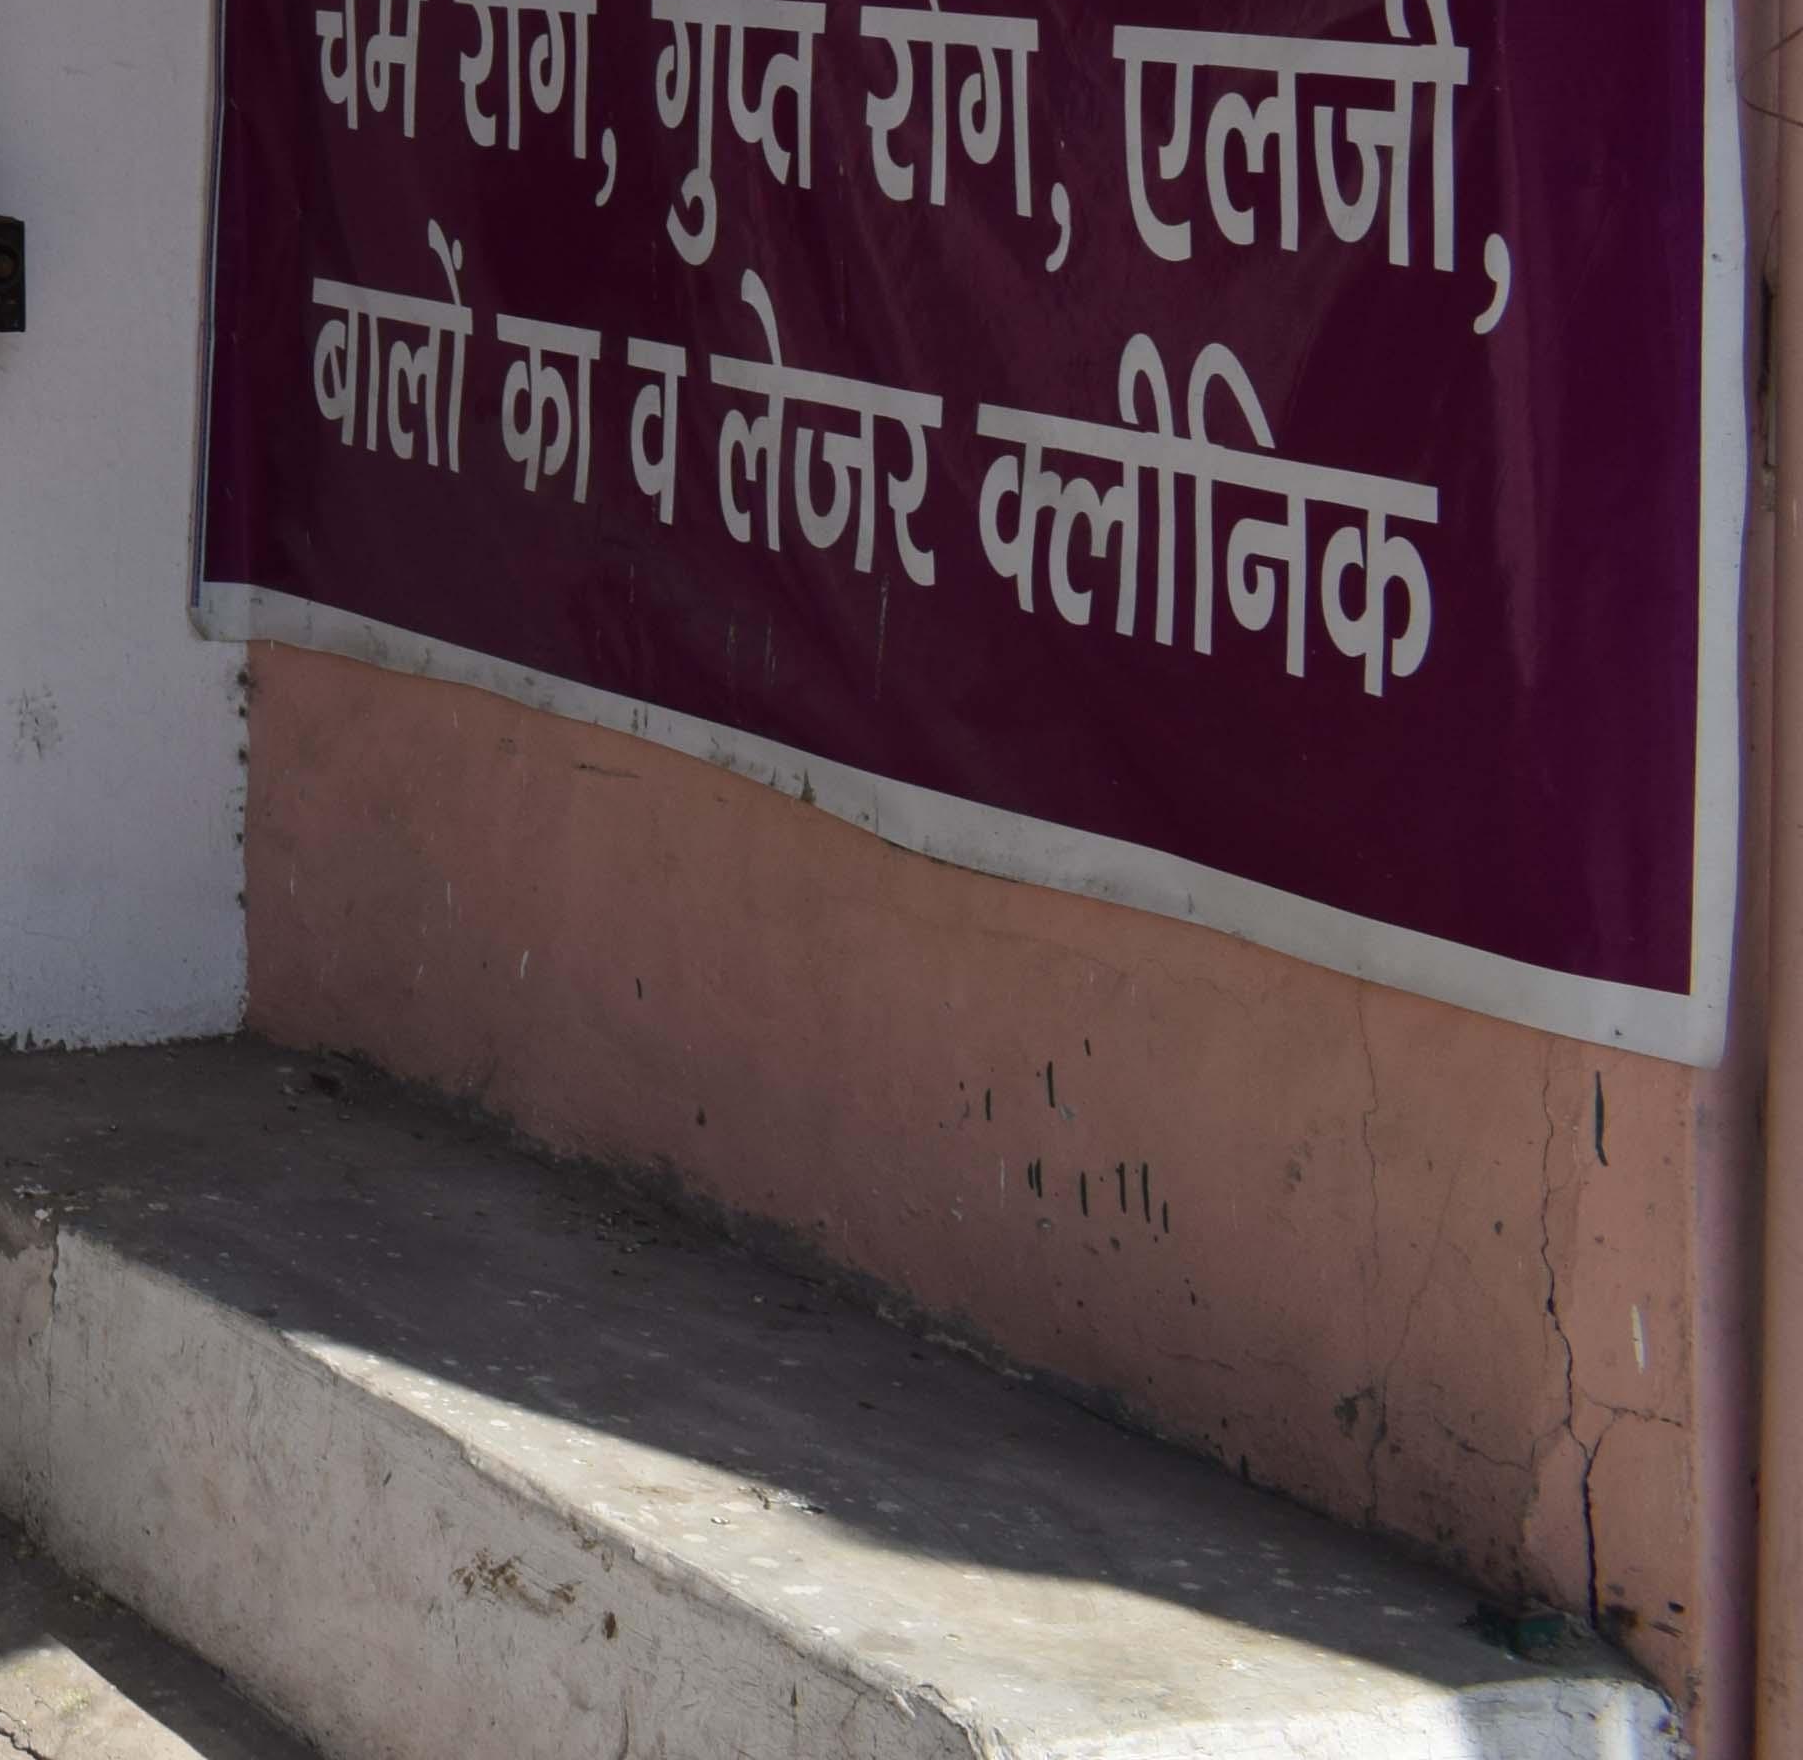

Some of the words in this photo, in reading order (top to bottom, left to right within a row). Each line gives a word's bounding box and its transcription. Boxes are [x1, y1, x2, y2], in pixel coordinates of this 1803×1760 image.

[313, 219, 473, 473] बालों
[497, 314, 601, 503] का
[628, 338, 686, 524] व
[710, 269, 943, 586] लेजर
[977, 333, 1438, 697] क्लीनिक
